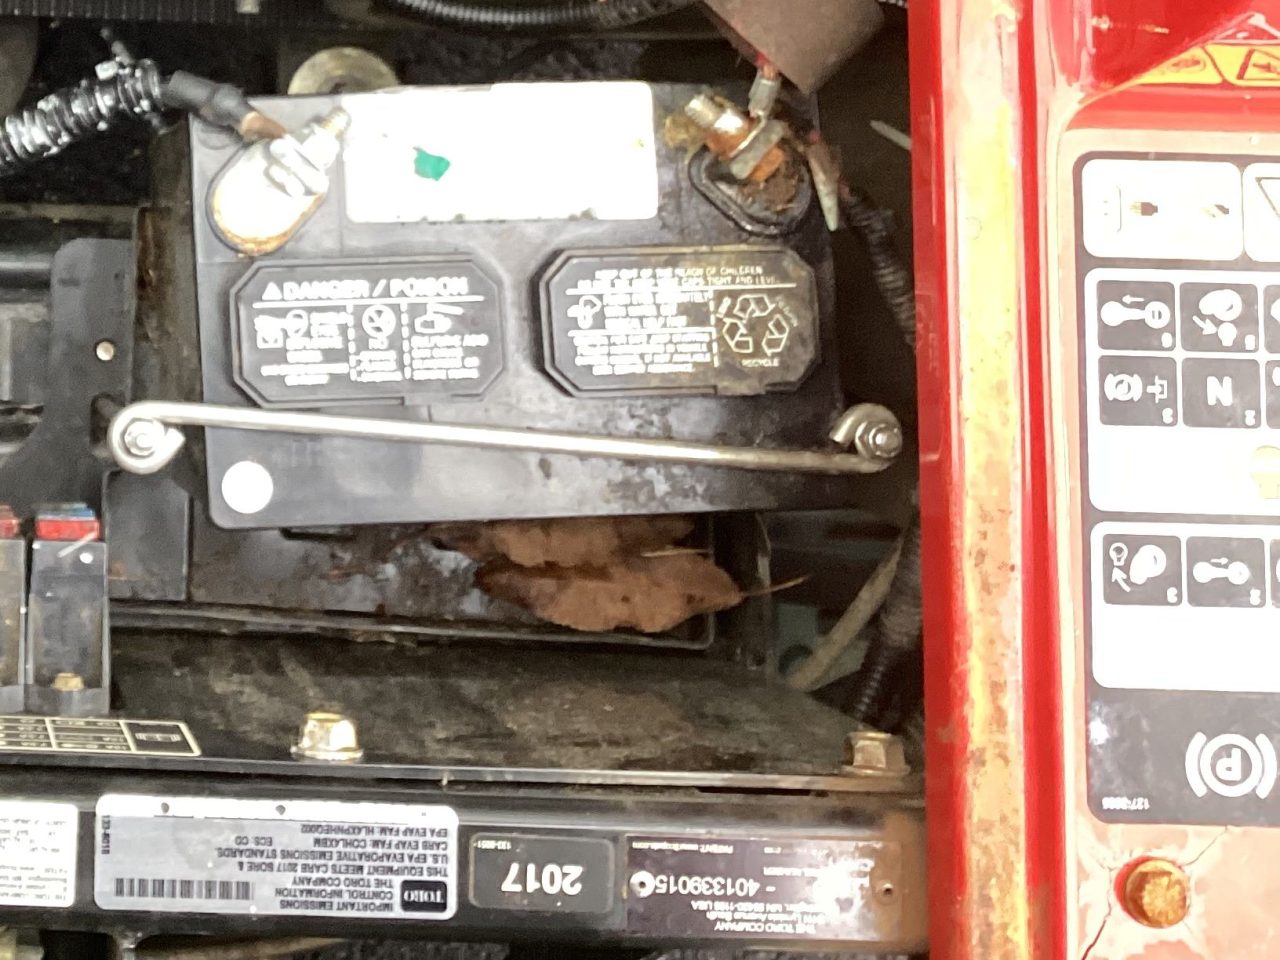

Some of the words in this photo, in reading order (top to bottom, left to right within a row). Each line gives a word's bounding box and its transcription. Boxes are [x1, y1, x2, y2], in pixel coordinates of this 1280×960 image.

[389, 277, 468, 298] POISON
[1206, 375, 1233, 407] N
[1215, 747, 1242, 782] P
[401, 826, 427, 838] EVAP
[429, 827, 448, 839] EPA
[394, 840, 419, 851] EVAP
[421, 840, 448, 851] CARB
[213, 847, 277, 859] STANDARDS.
[279, 849, 334, 861] EMISSIONS
[335, 851, 405, 863] EVAPORATIVE
[406, 852, 427, 863] EPA
[429, 853, 448, 865] U.S.
[276, 862, 298, 873] 2017
[300, 862, 329, 874] CARB
[331, 864, 364, 875] MEETS
[366, 865, 424, 877] EQUIPMENT
[426, 866, 448, 878] THIS
[291, 875, 341, 888] COMPANY
[343, 877, 371, 889] TORO
[373, 878, 393, 890] THE
[500, 862, 583, 896] 2017
[274, 887, 343, 899] INFORMATION
[344, 889, 393, 901] CONTROL
[402, 889, 444, 904] TORO
[279, 899, 334, 911] EMISSIONS
[336, 900, 393, 913] IMPORTANT
[713, 920, 765, 933] COMPANY
[765, 922, 795, 934] TORO
